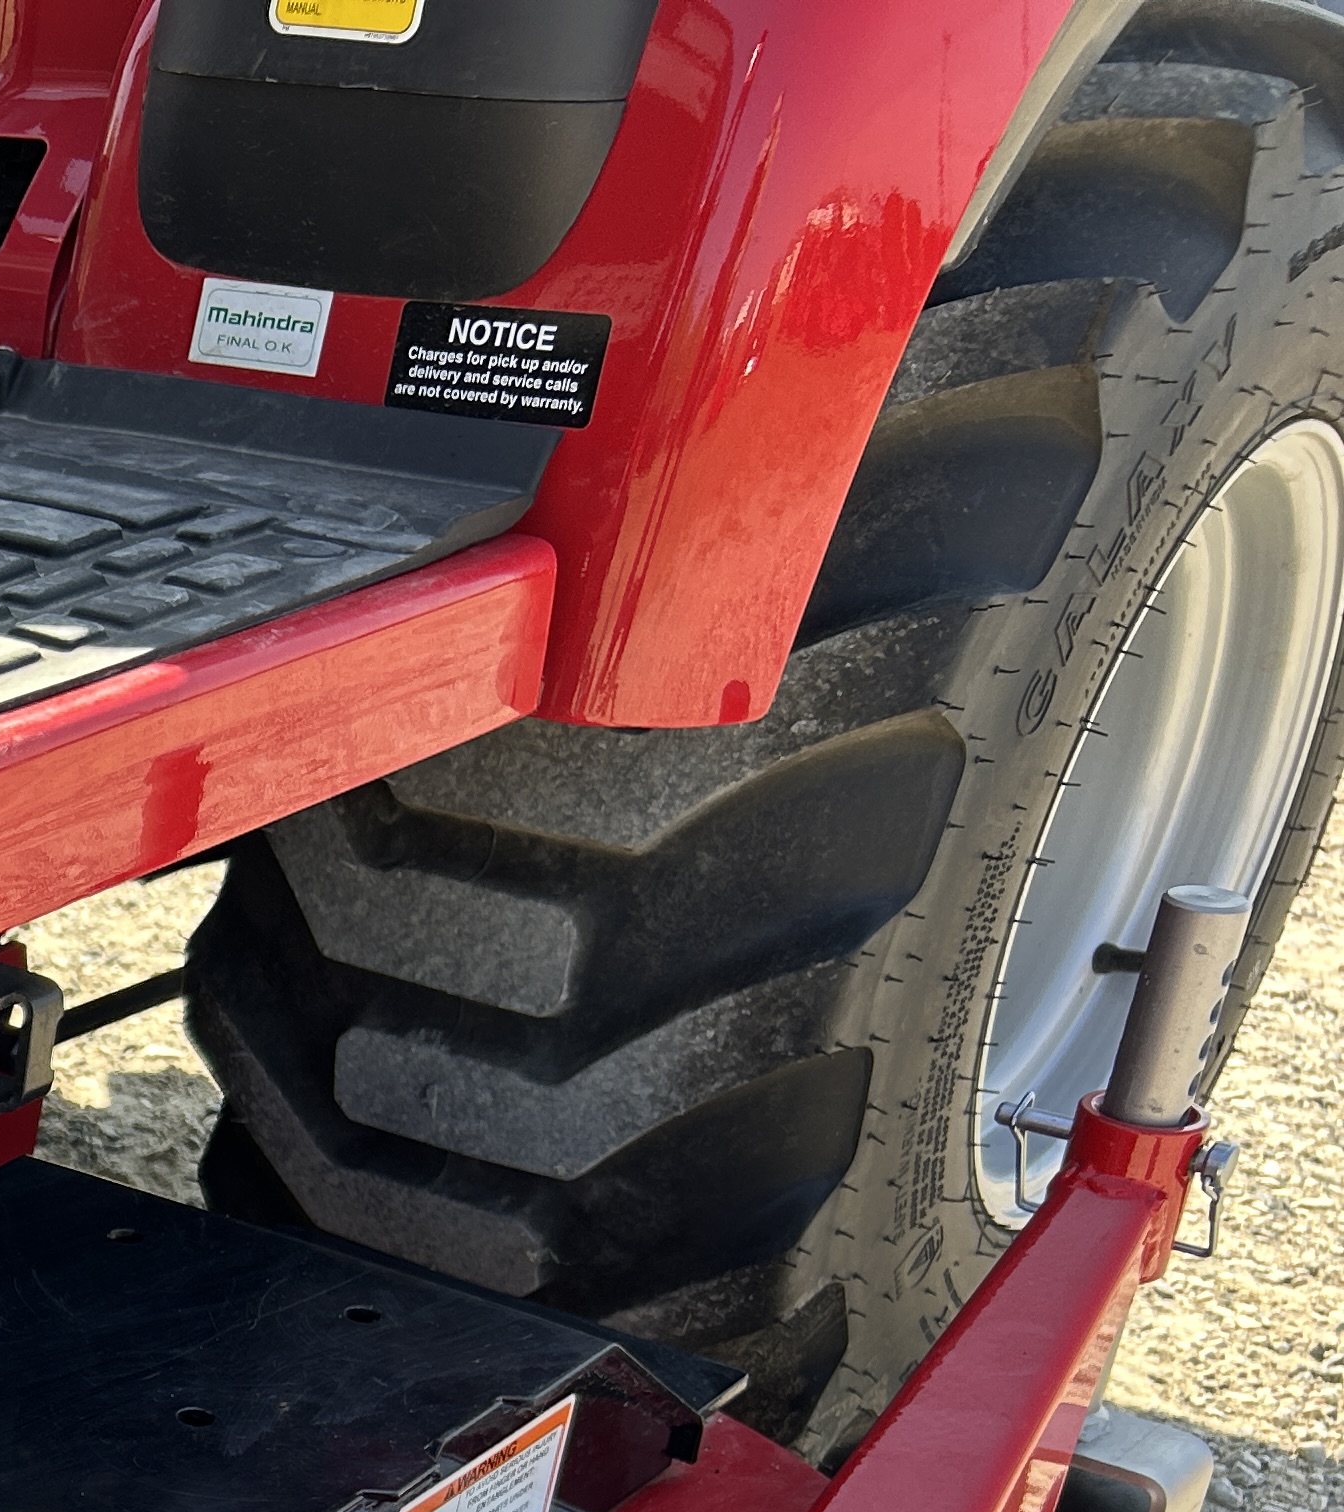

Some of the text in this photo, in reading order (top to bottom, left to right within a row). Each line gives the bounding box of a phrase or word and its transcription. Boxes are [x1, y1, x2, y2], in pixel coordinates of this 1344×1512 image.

[207, 307, 313, 334] Mahindra
[449, 318, 557, 352] NOTICE
[217, 334, 259, 353] FINAL
[409, 346, 588, 376] Charges for pick up and/or
[409, 365, 578, 393] delivery and service calls
[394, 384, 584, 413] are not covered by warranty.
[456, 1442, 518, 1495] WARNING
